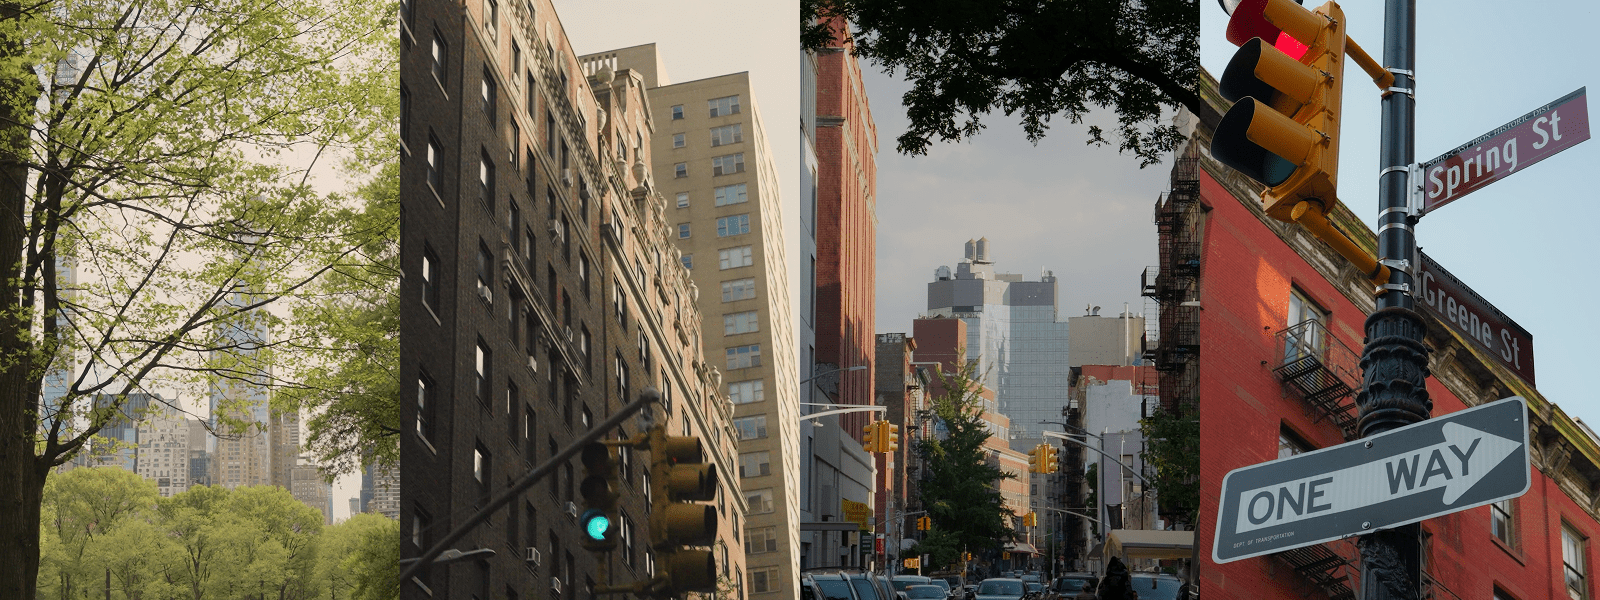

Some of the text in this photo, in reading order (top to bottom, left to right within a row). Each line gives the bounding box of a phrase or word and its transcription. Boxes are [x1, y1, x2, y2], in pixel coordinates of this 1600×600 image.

[1428, 110, 1562, 199] Spring St
[1472, 133, 1491, 146] IRON
[1493, 114, 1531, 135] HISTORIC
[1533, 104, 1550, 117] DIST
[1422, 271, 1520, 370] Greene St
[1247, 437, 1482, 525] ONE WAY
[1233, 541, 1245, 549] DEPT
[1255, 531, 1295, 543] TRANSPORTATION
